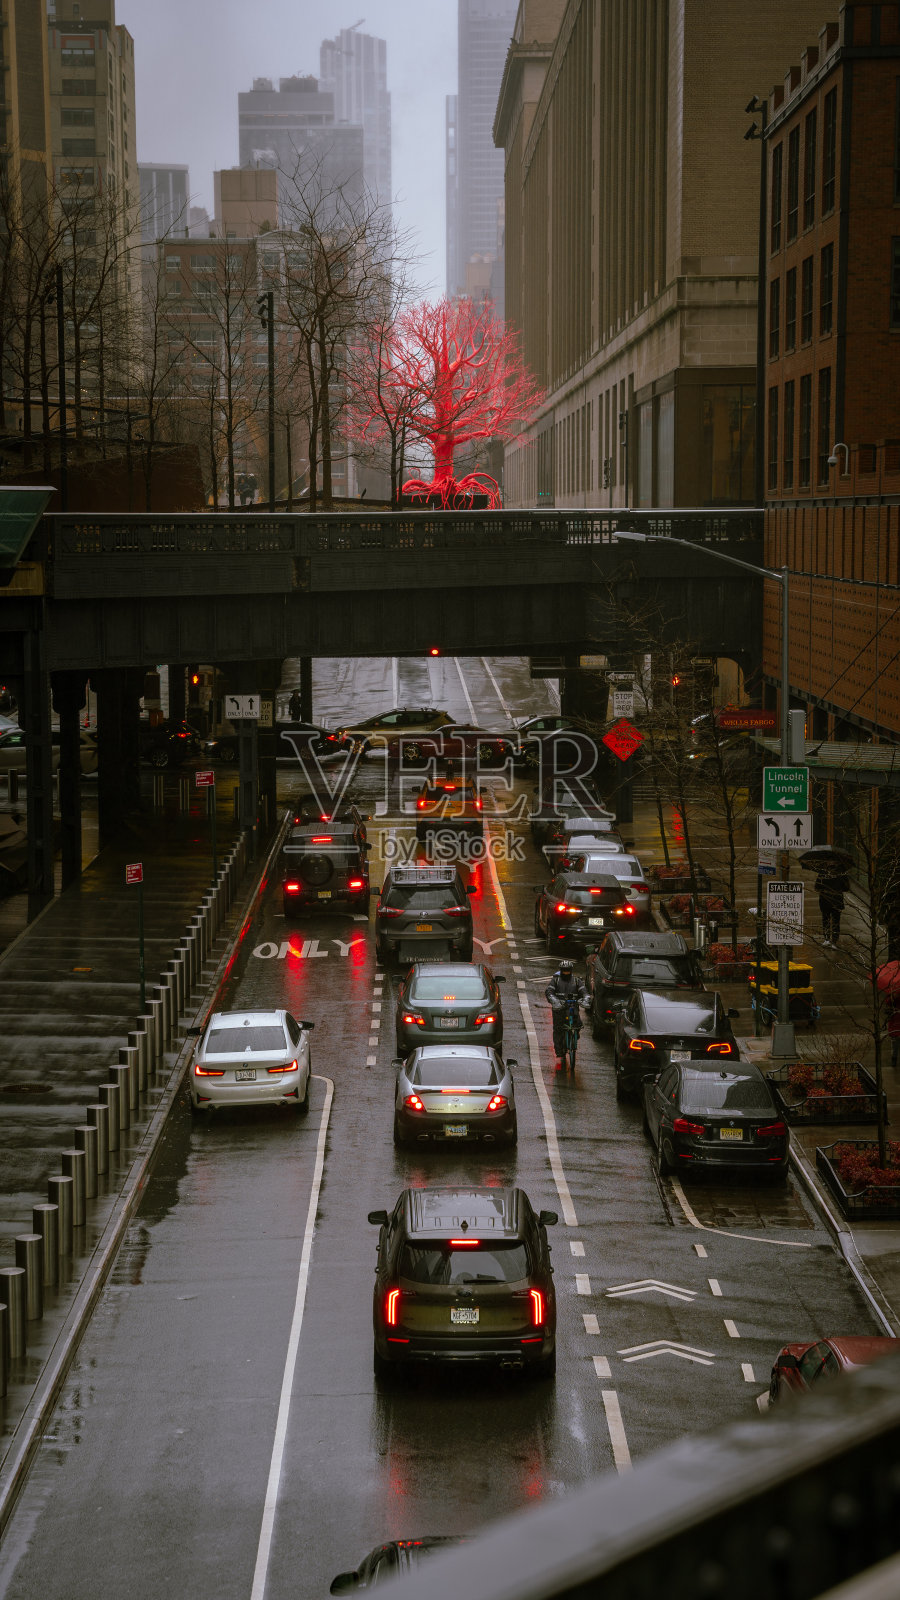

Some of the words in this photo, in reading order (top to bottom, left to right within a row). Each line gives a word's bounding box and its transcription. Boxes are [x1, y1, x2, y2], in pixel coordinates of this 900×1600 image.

[768, 772, 804, 781] Lincoln
[769, 784, 803, 793] Tunnel
[761, 838, 782, 847] ONLY
[787, 838, 809, 847] ONLY
[769, 884, 788, 892] STATE
[789, 884, 801, 892] LAW
[252, 938, 367, 959] ONLY
